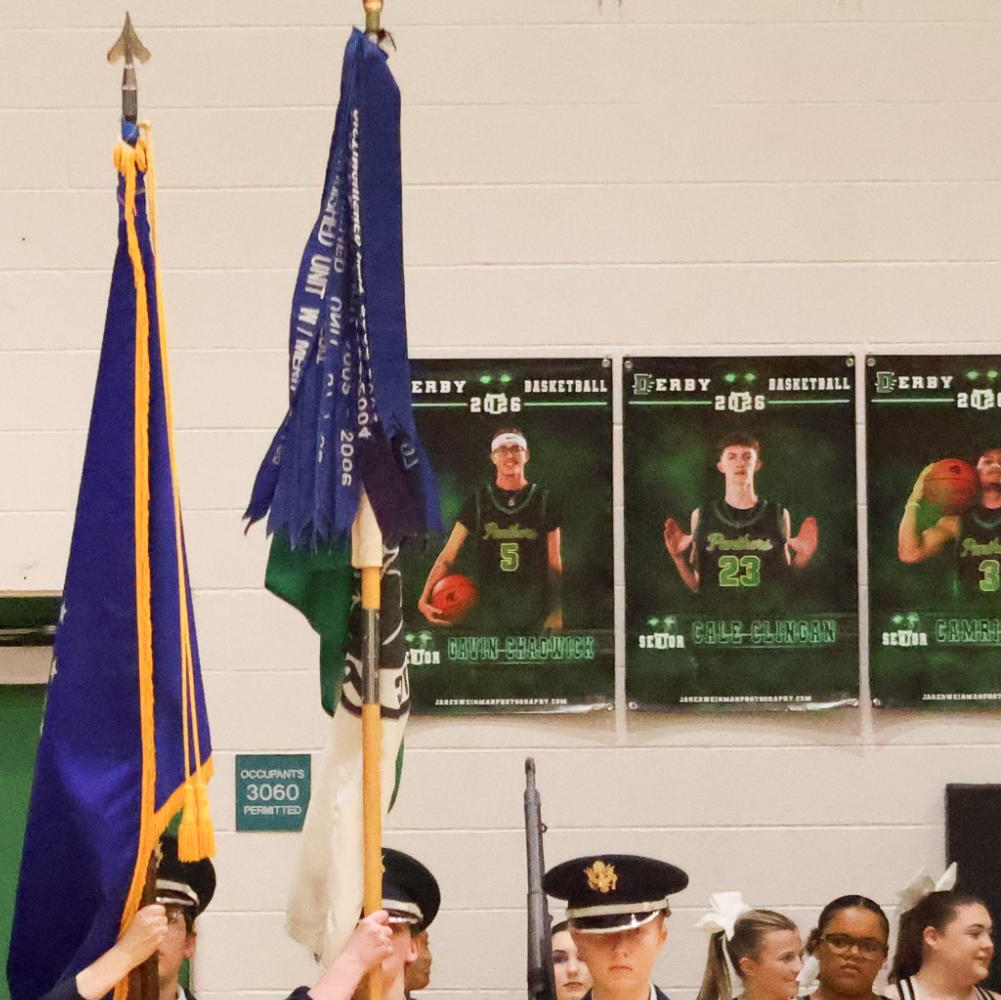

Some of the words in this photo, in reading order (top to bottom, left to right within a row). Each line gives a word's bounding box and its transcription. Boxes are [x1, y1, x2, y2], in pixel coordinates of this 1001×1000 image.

[305, 253, 333, 300] UNIT
[411, 380, 467, 394] ERBY
[524, 380, 609, 393] BASKETBALL
[633, 373, 712, 395] DERBY
[768, 377, 851, 391] BASKETBALL
[875, 371, 954, 393] DERBY
[470, 395, 522, 414] 2026
[714, 393, 766, 412] 2026
[956, 391, 1001, 409] 202
[339, 428, 355, 487] 2006
[500, 542, 519, 572] 5
[718, 555, 761, 587] 23
[978, 559, 1000, 592] 3
[692, 619, 743, 645] CALE
[447, 636, 499, 661] GAVIN
[504, 635, 596, 661] CHADWICK
[240, 768, 305, 780] OCCUPANTS
[246, 783, 300, 801] 3060
[243, 805, 302, 816] PERMITTED
